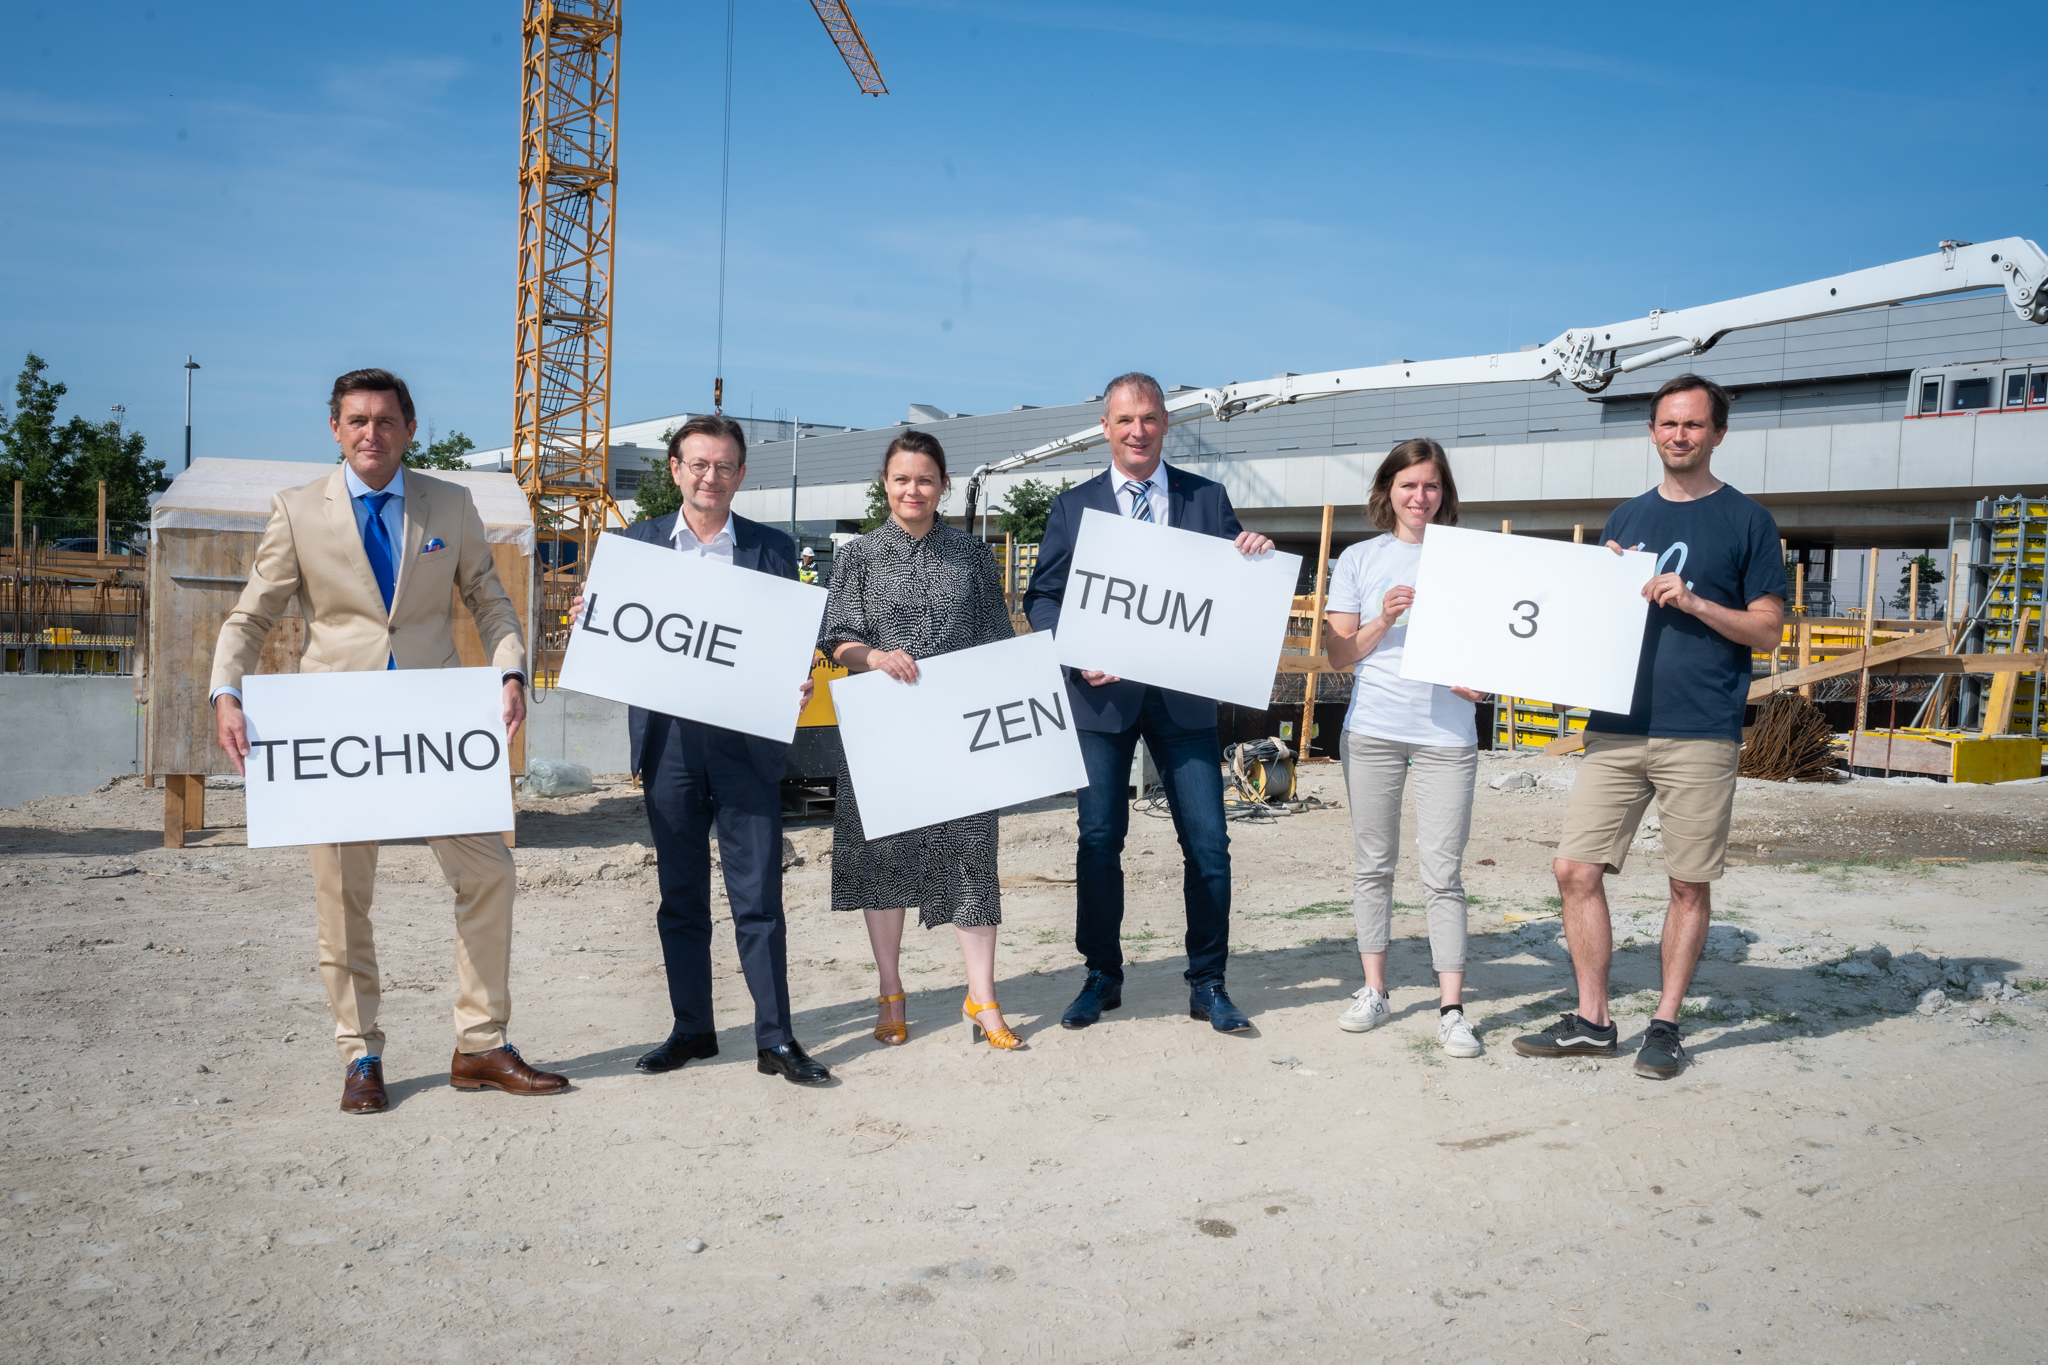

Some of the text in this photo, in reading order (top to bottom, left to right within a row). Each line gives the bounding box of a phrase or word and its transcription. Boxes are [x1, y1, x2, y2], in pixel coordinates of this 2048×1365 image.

[582, 592, 743, 668] LOGIE
[1075, 569, 1213, 636] TRUM
[1508, 599, 1540, 639] 3
[962, 692, 1067, 753] ZEN
[250, 729, 500, 782] TECHNO
